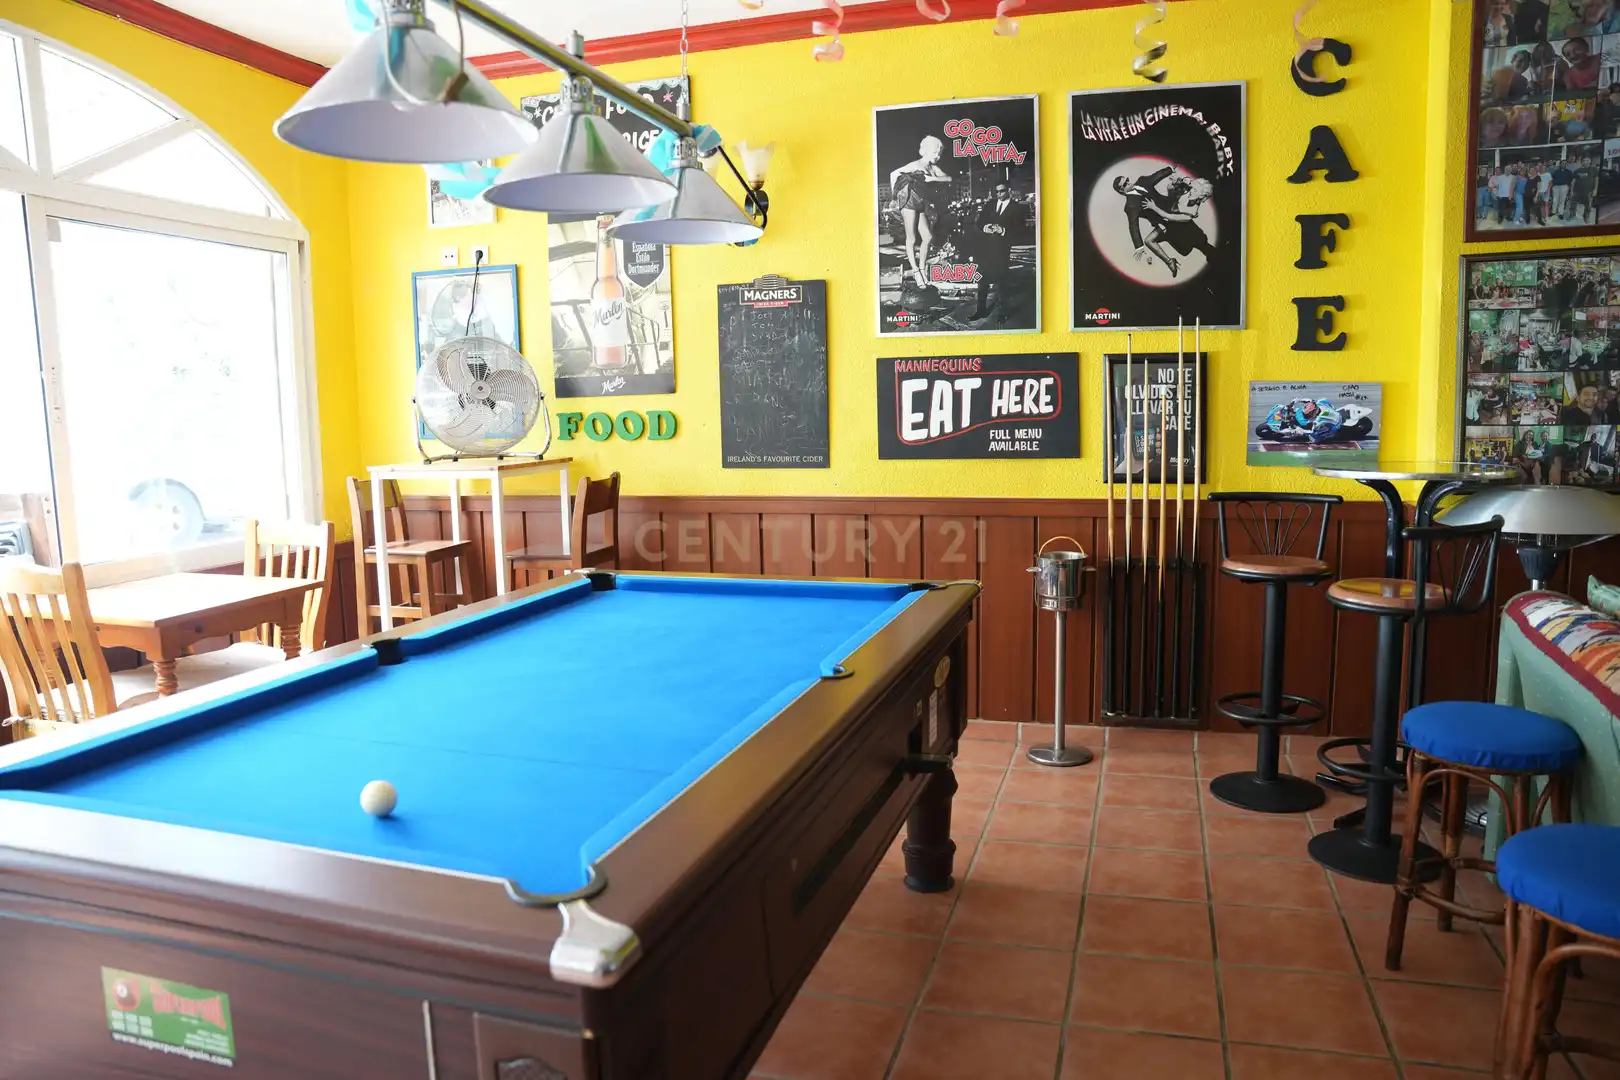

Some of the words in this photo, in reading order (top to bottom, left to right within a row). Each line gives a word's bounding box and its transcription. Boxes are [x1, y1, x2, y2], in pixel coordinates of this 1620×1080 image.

[944, 119, 975, 138] GO
[971, 126, 1003, 145] GO
[1081, 124, 1097, 141] LA
[1094, 127, 1122, 142] VITA
[1128, 119, 1146, 136] UN
[953, 138, 980, 157] LA
[1285, 37, 1360, 352] CAFE
[744, 288, 798, 301] MAGNERS
[886, 315, 919, 323] MARTINI
[1085, 313, 1121, 321] MARTINI
[895, 357, 983, 375] MANNEQUINS
[1157, 368, 1175, 384] NO
[901, 377, 982, 441] EAT
[991, 377, 1055, 418] HERE
[556, 410, 678, 441] FOOD
[1164, 415, 1192, 431] CAE
[989, 429, 1011, 440] FULL
[1014, 428, 1043, 440] MENU
[988, 441, 1040, 451] AVAILABLE
[727, 455, 762, 463] IRELAND'S
[763, 455, 801, 463] FAVOURITE
[802, 455, 824, 463] CIDER
